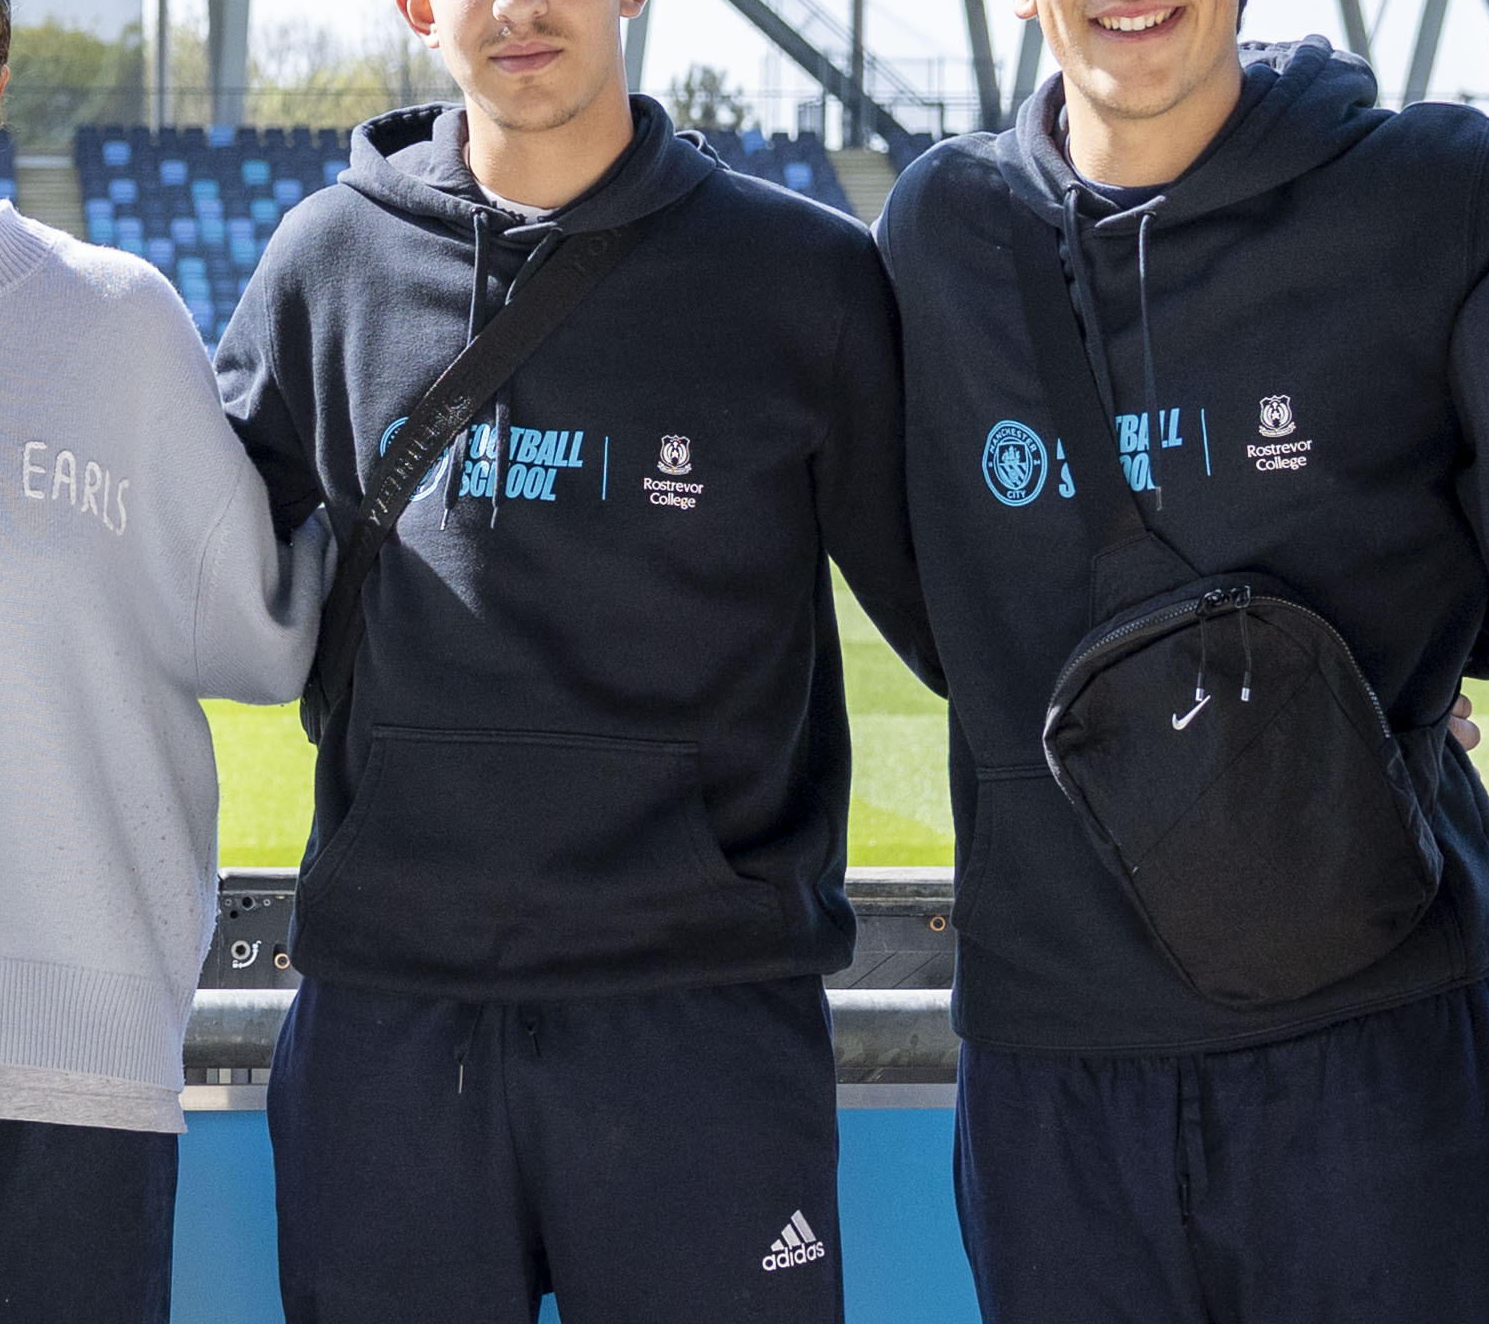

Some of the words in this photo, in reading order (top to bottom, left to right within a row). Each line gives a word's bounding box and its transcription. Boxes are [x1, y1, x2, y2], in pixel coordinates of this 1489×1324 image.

[990, 428, 1038, 454] MANCHESTER
[1246, 440, 1313, 460] Rostrevor
[1255, 455, 1308, 472] College
[23, 441, 130, 536] EARLS
[642, 477, 704, 494] Rostrevor
[1006, 489, 1027, 499] CITY
[649, 492, 696, 510] College
[762, 1242, 825, 1271] adidas
